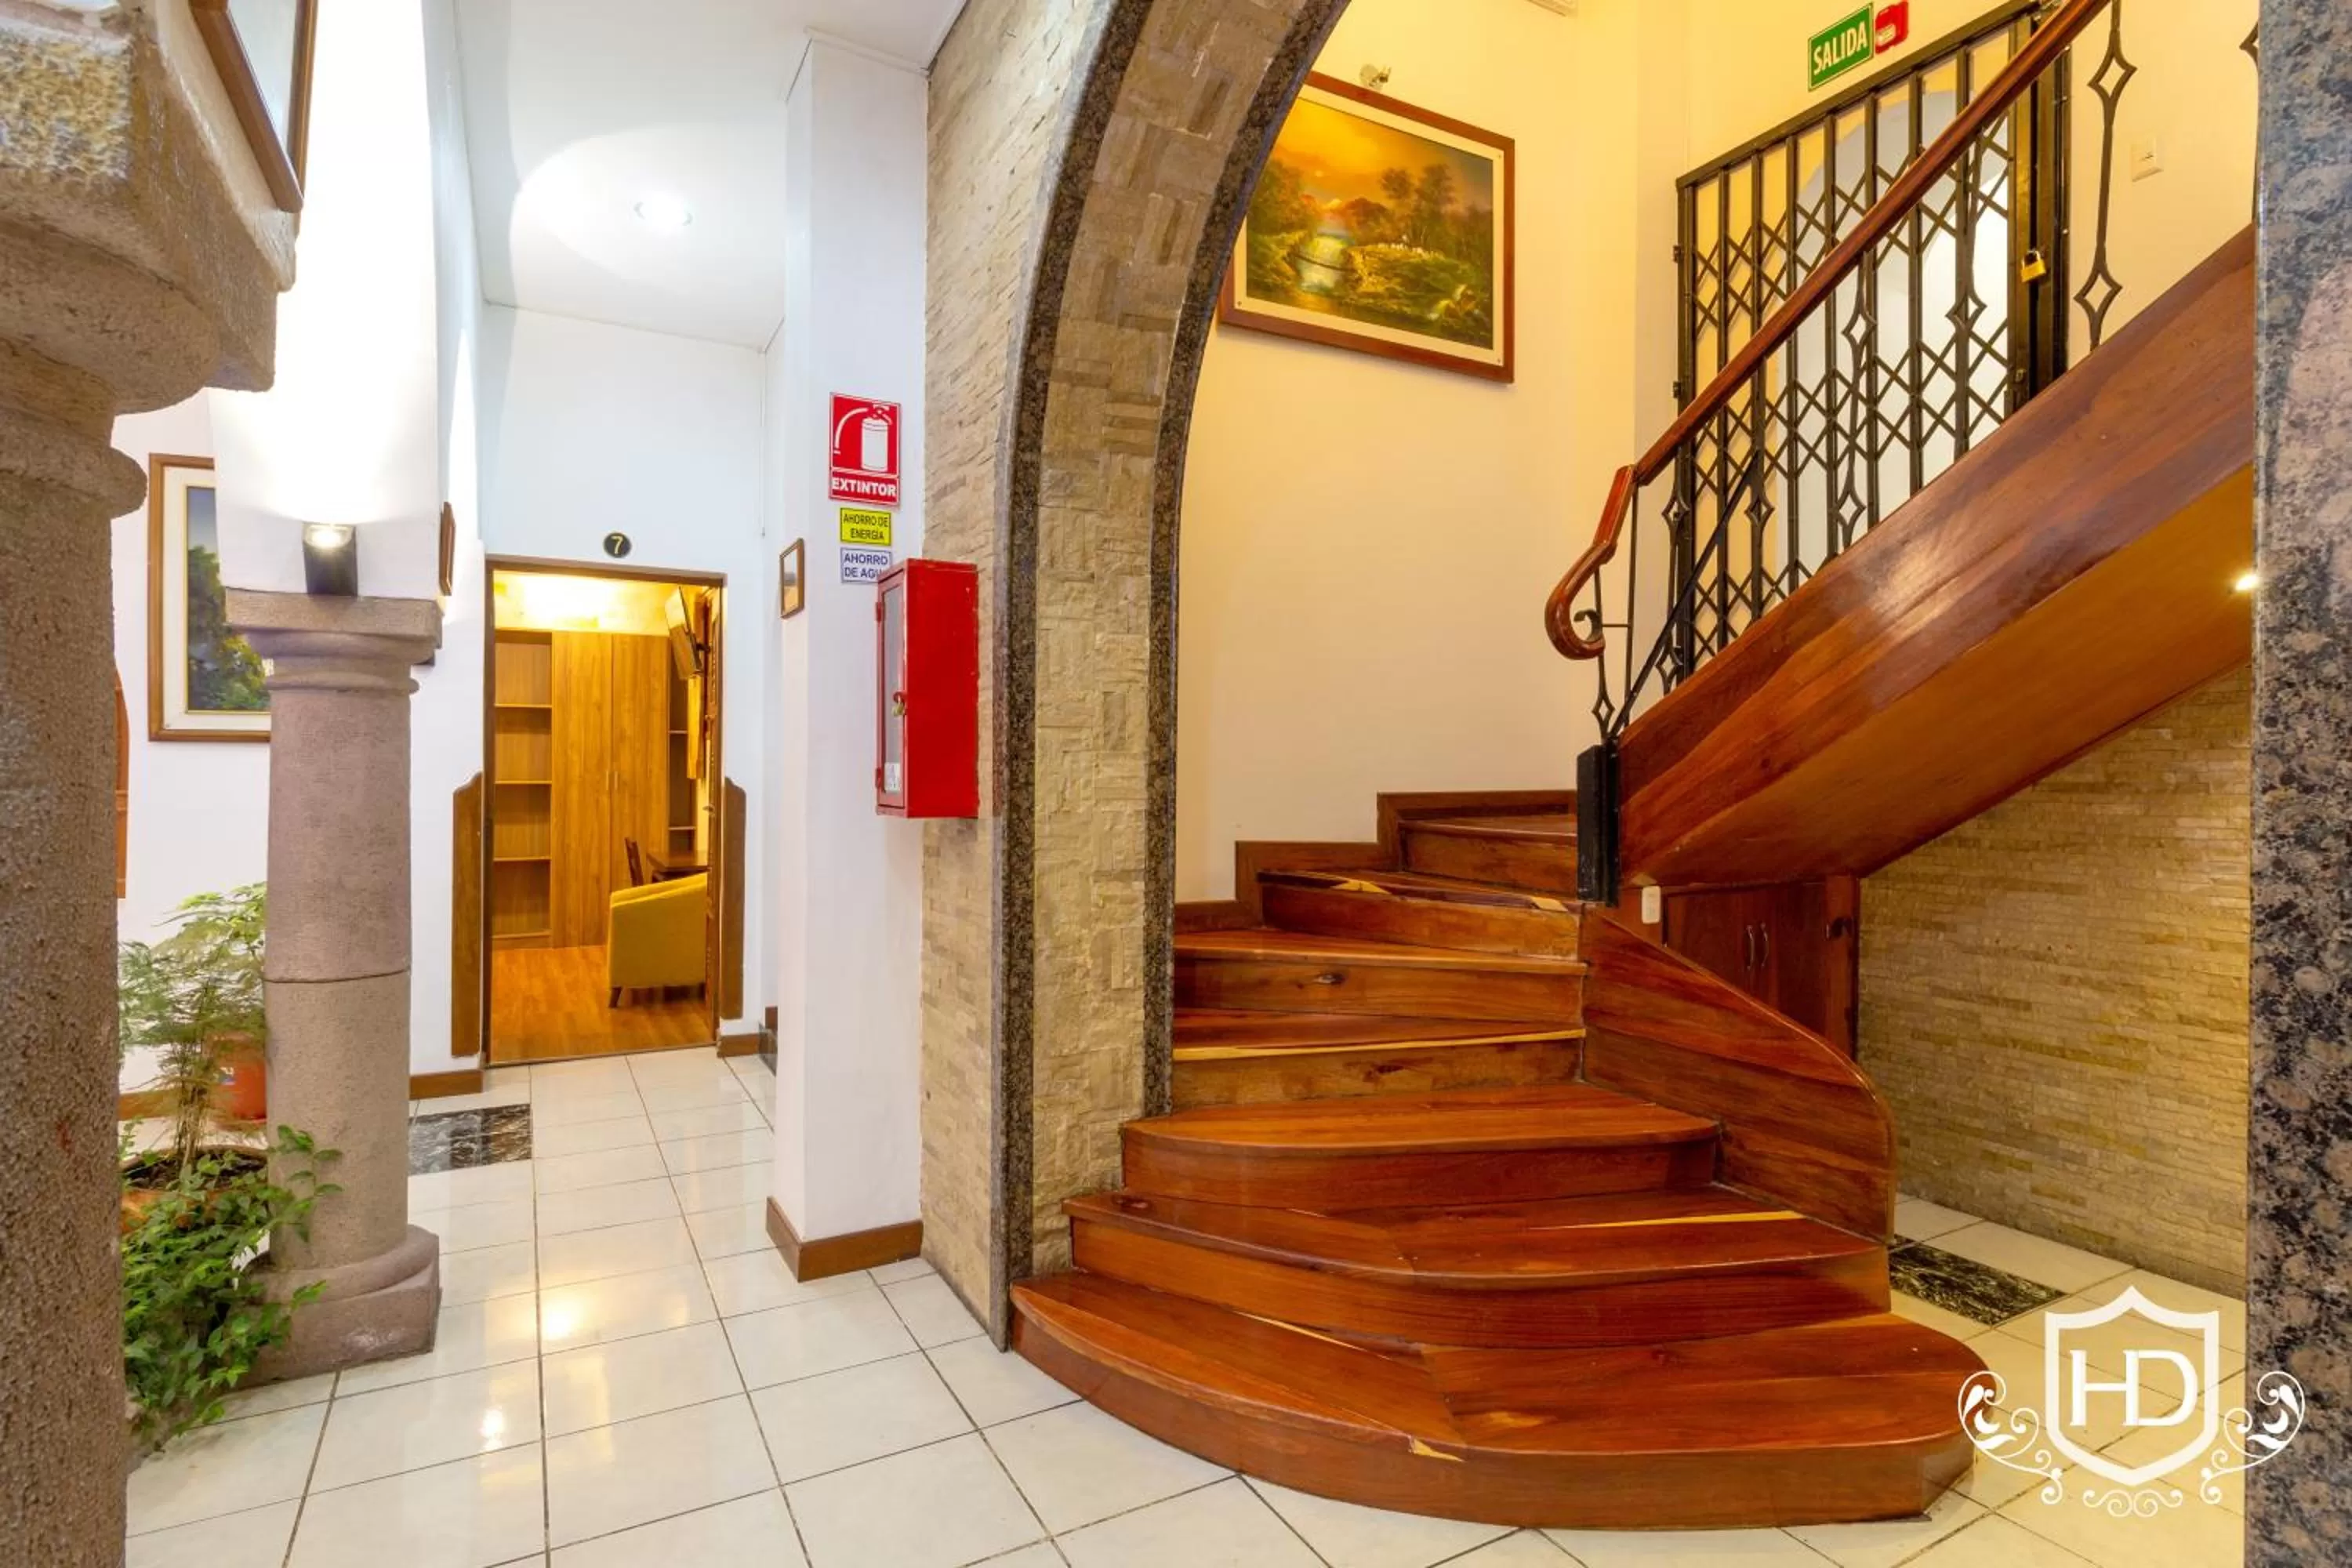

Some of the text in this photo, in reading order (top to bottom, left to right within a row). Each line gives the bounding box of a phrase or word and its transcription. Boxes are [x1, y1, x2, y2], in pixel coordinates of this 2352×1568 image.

[1813, 21, 1868, 76] SALIDA
[832, 477, 897, 496] EXTINTOR
[843, 514, 888, 528] AHORRO DE
[612, 535, 623, 554] 7
[844, 553, 888, 565] AHORRO
[844, 567, 858, 578] DE
